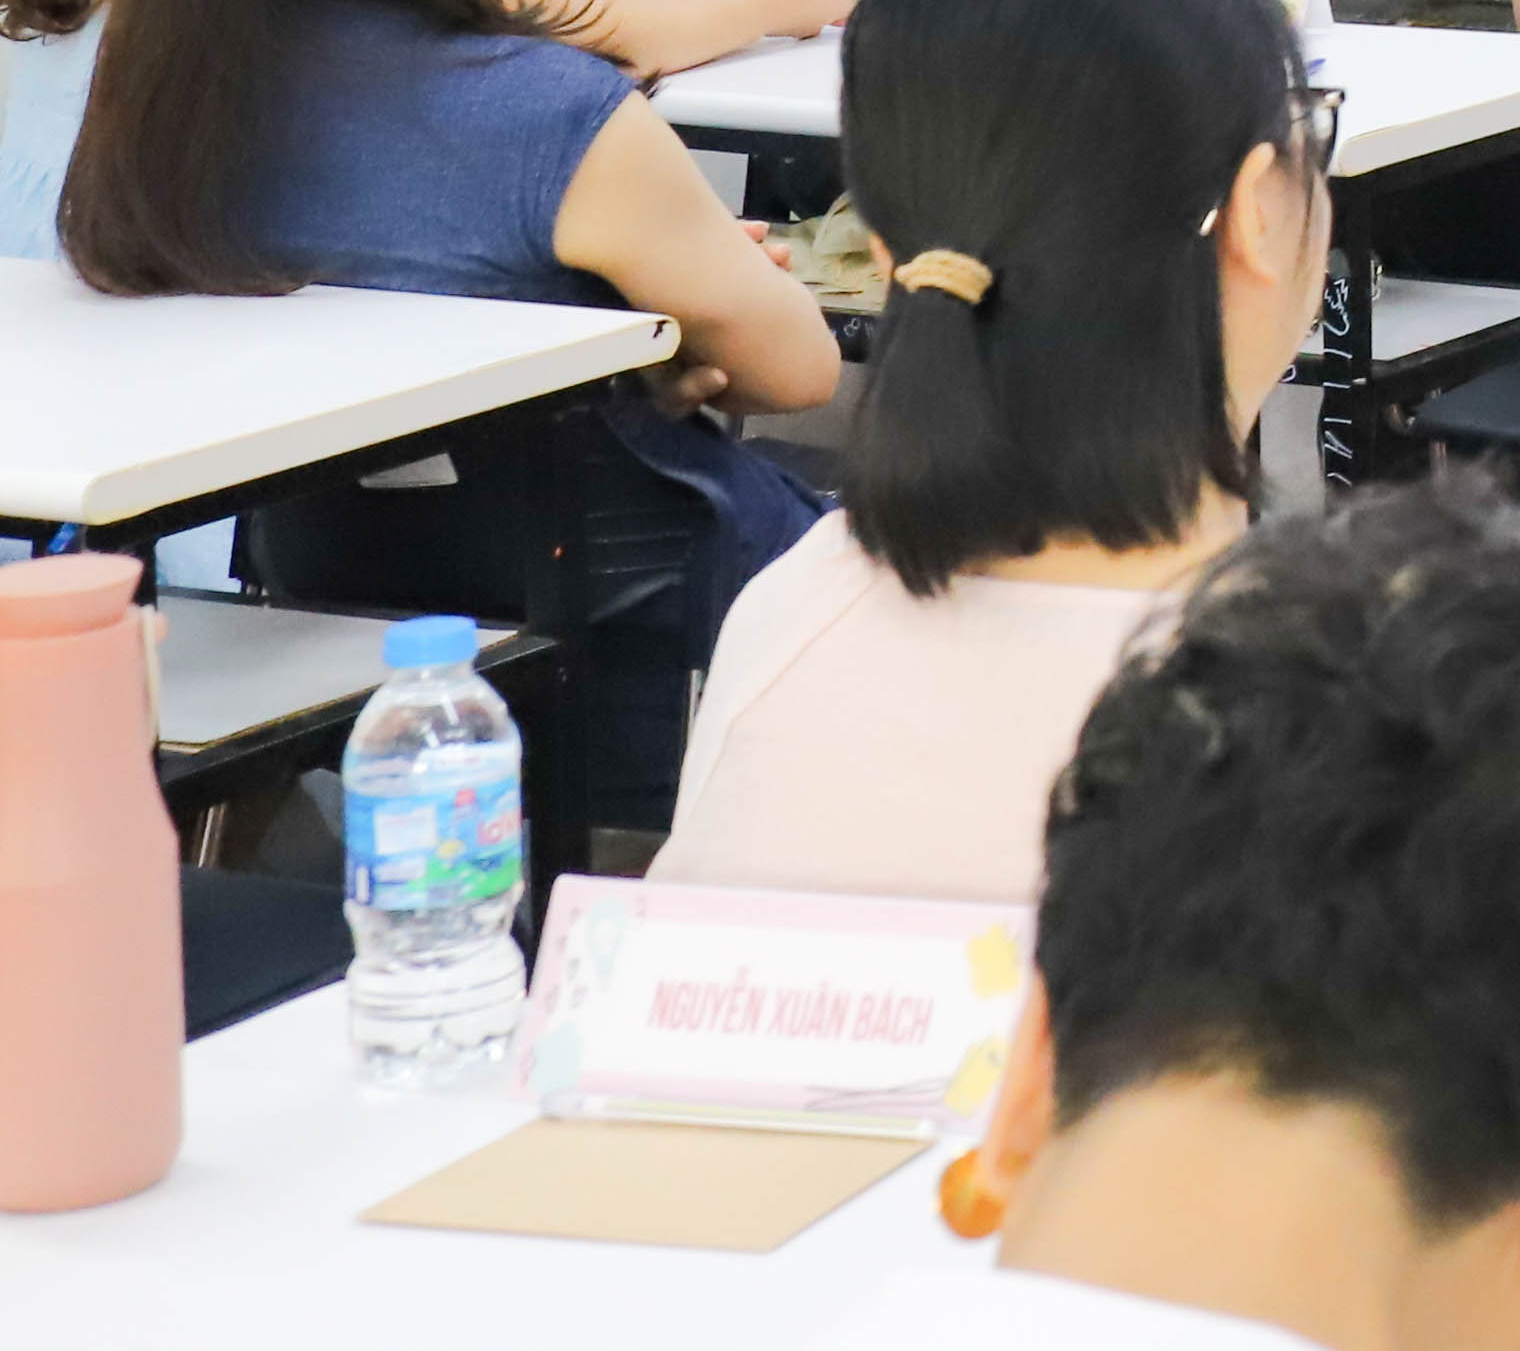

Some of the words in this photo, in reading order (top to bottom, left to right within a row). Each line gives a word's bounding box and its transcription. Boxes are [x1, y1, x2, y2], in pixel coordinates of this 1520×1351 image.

[648, 965, 766, 1034] NGUYỄN
[767, 980, 850, 1039] XUÂN
[851, 986, 935, 1045] BÁCH
